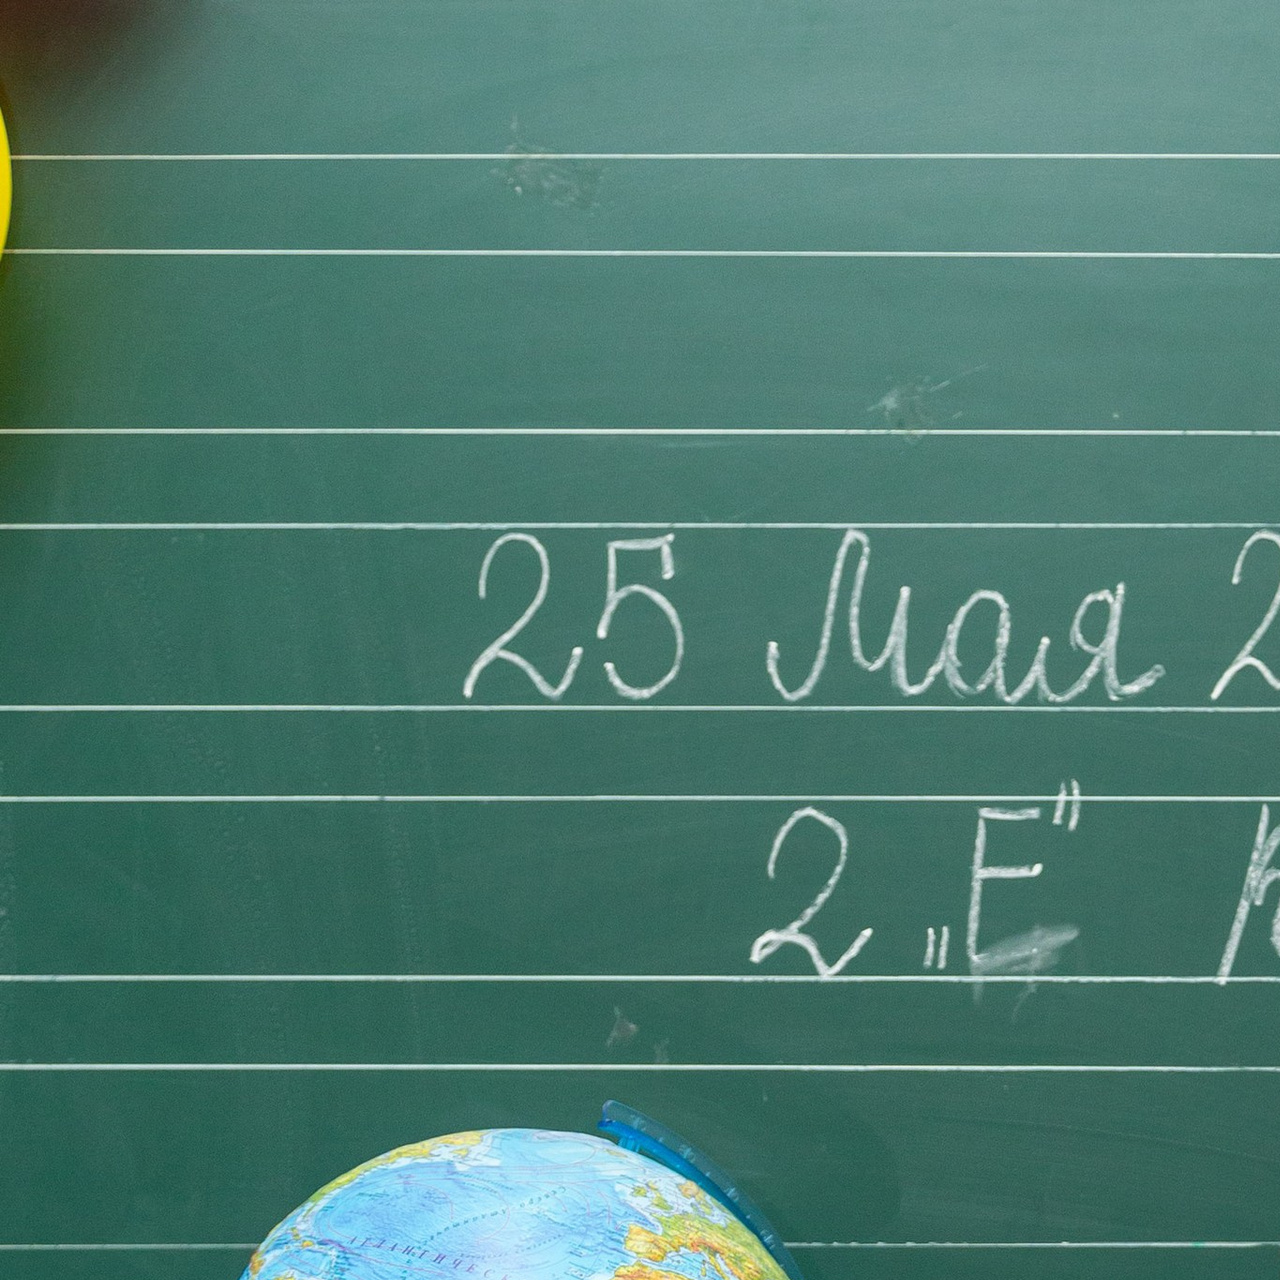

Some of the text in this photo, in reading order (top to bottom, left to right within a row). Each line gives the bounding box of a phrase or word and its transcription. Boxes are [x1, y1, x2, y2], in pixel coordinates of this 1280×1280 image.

[463, 531, 685, 700] 25
[765, 529, 1166, 703] Мая
[750, 804, 873, 978] 2
